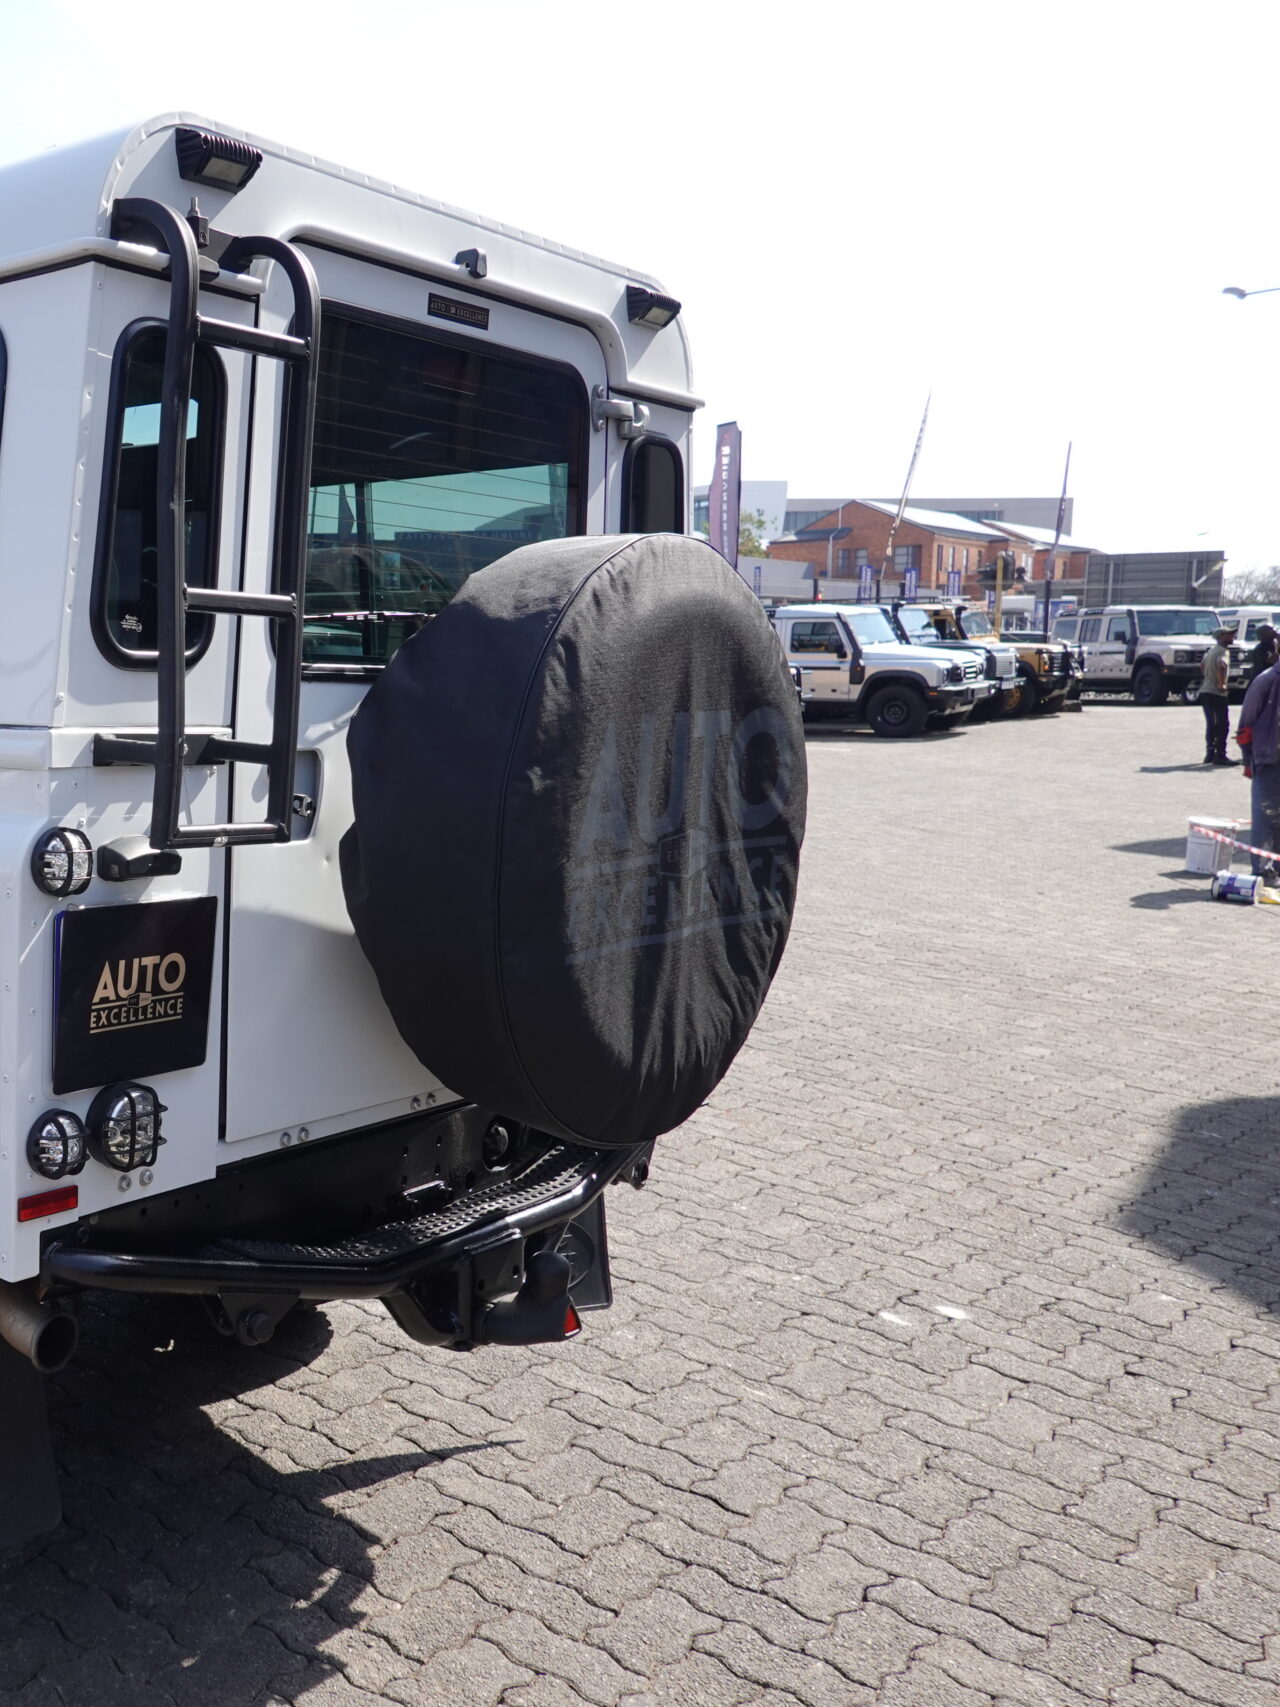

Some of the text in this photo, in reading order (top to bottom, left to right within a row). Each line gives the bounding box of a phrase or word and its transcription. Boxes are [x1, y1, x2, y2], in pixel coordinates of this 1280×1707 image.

[431, 301, 446, 311] AUTO
[576, 706, 794, 857] AUTO
[91, 952, 186, 1003] AUTO
[89, 998, 183, 1028] EXCELLENCE
